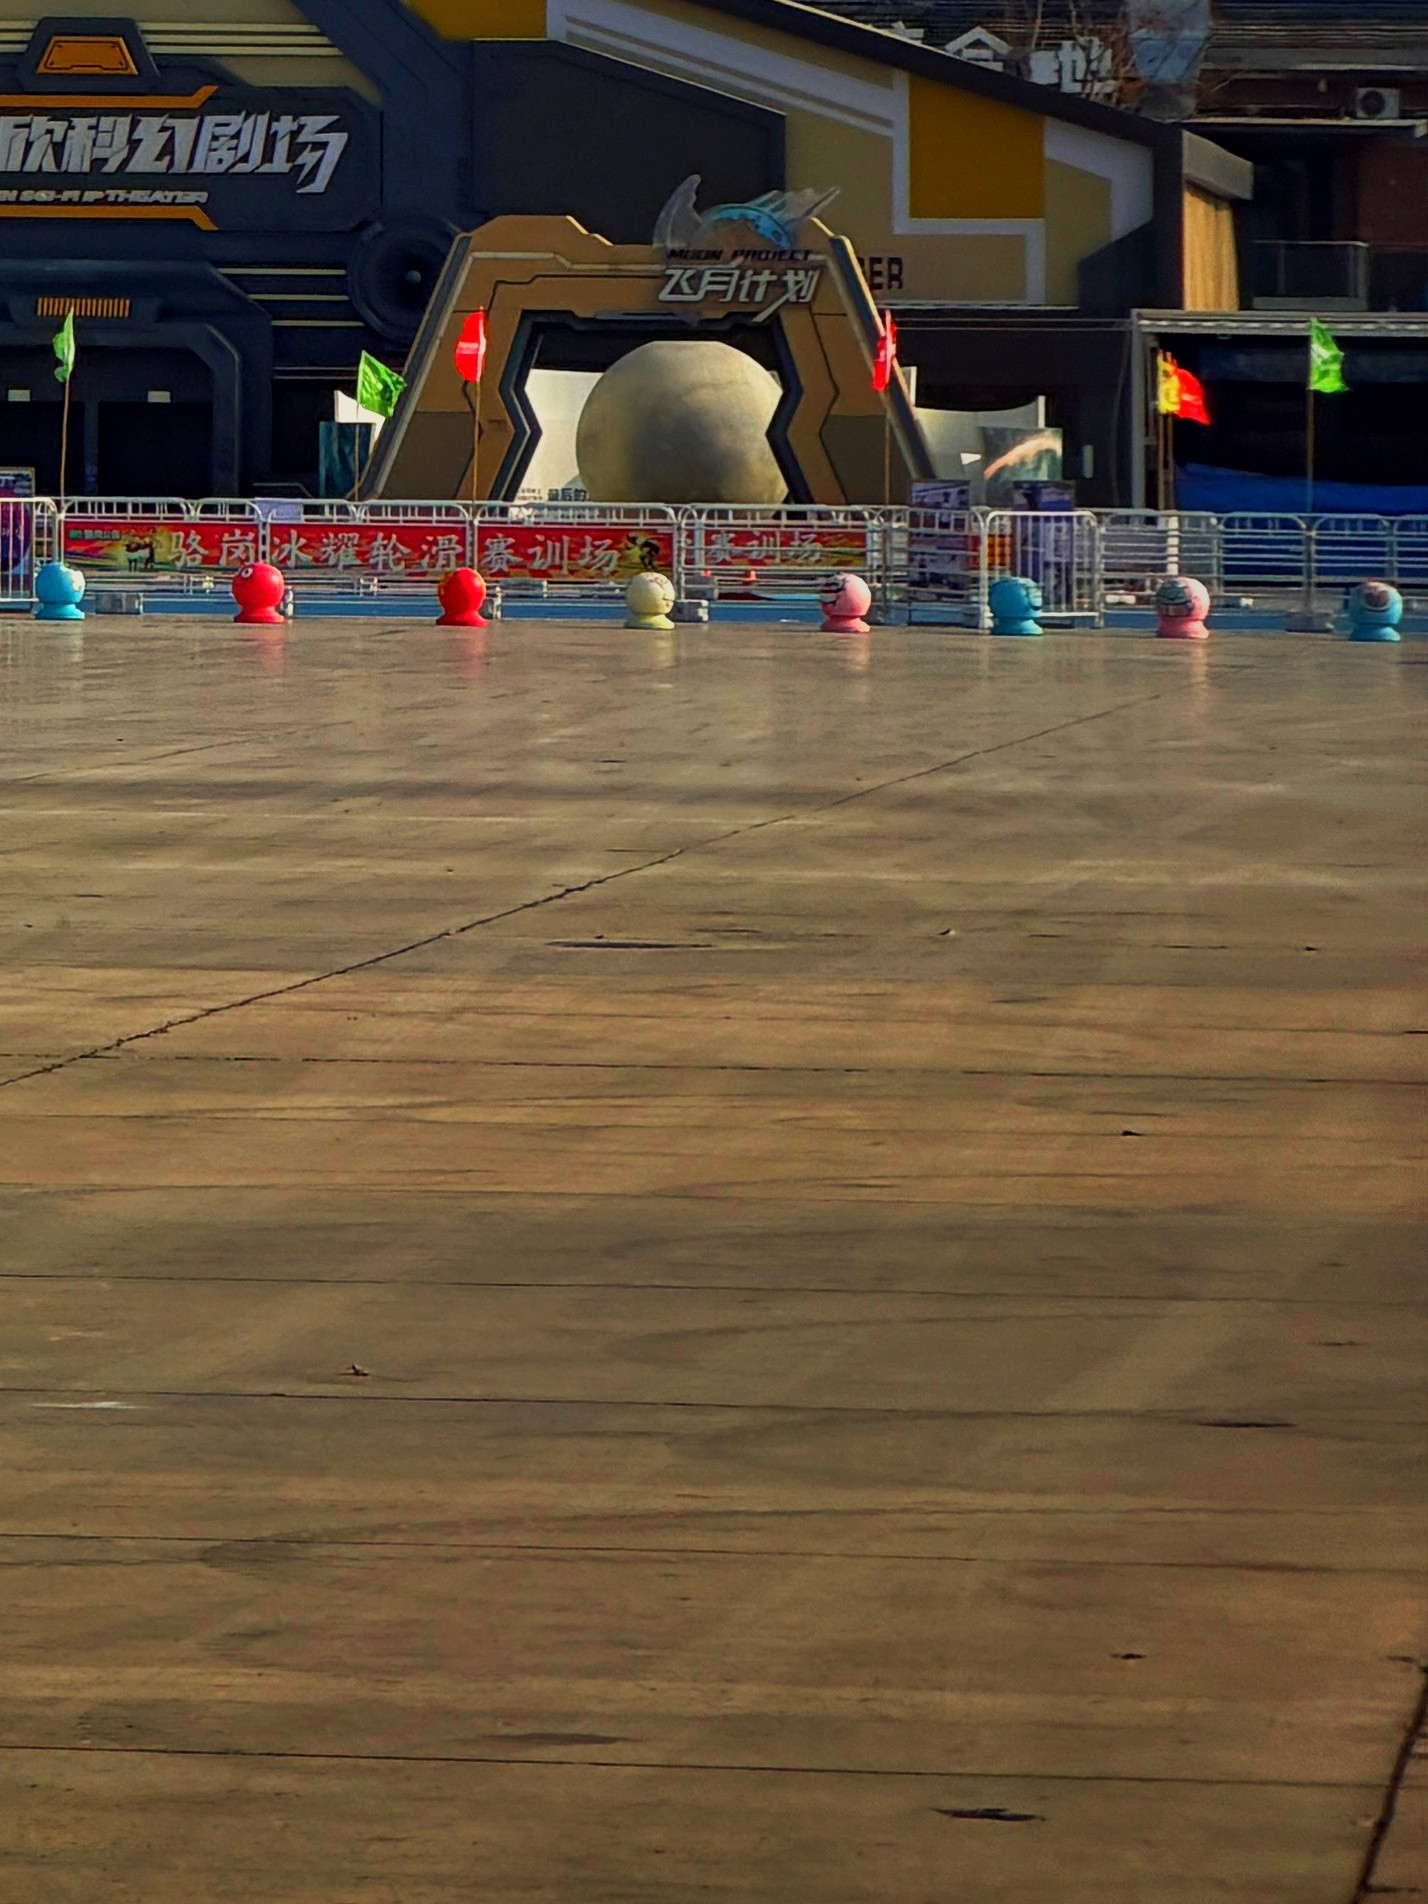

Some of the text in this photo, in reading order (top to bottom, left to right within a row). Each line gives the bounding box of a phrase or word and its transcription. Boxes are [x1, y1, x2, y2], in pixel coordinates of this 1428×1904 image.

[657, 268, 822, 323] 飞月计划
[857, 256, 905, 291] ER
